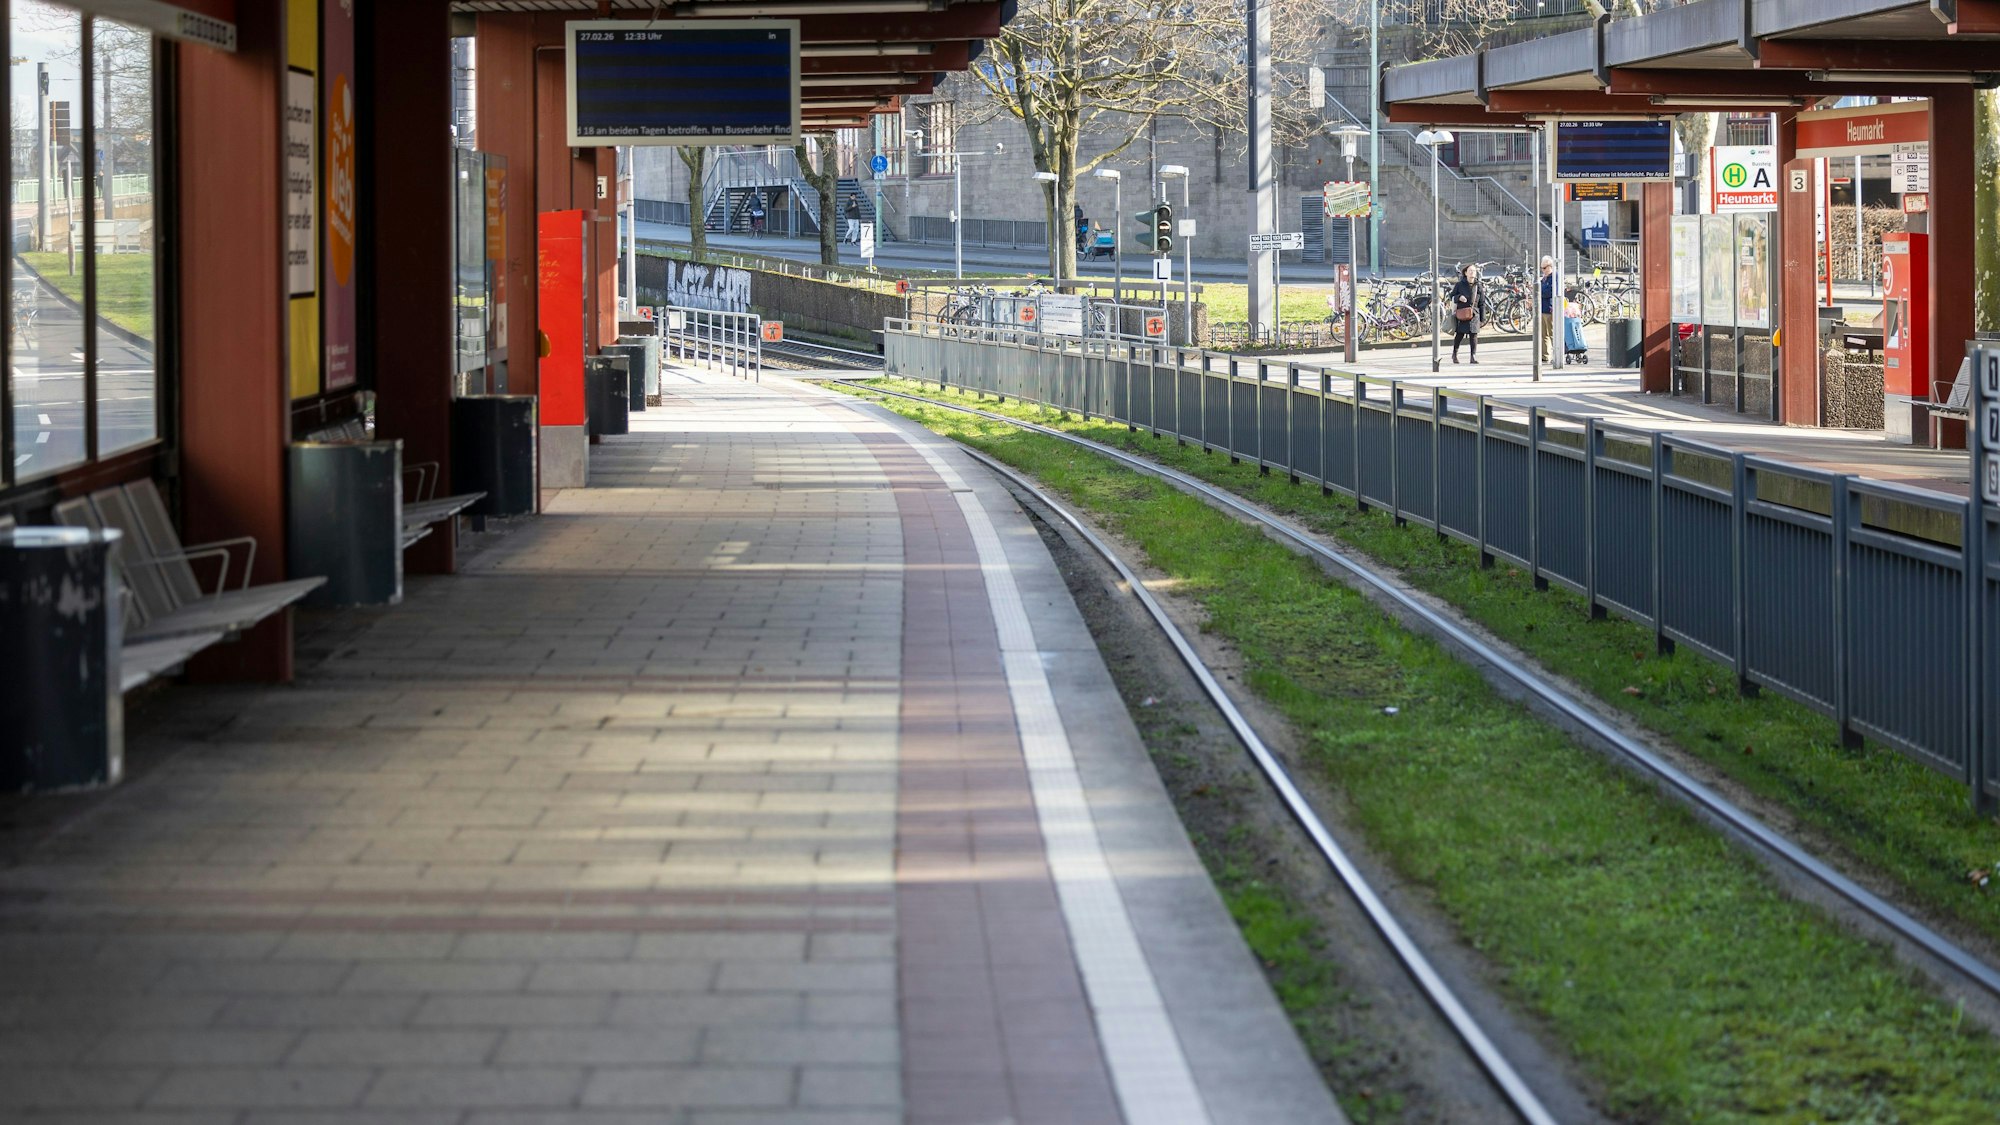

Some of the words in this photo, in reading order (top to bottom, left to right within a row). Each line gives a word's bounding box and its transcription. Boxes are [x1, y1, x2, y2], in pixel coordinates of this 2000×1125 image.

[580, 33, 615, 41] 27.02.26
[624, 33, 646, 41] 12:33
[648, 32, 663, 40] Uhr
[768, 32, 776, 40] in
[583, 127, 595, 135] 18
[608, 126, 639, 135] beiden
[640, 126, 666, 136] Tagen
[667, 125, 710, 135] betroffen.
[712, 126, 724, 134] Im
[725, 125, 772, 135] Busverkehr
[774, 125, 791, 134] find
[1846, 118, 1885, 142] Heumarkt
[331, 139, 354, 222] lieb
[1753, 168, 1771, 188] A
[1793, 177, 1804, 191] 3
[1719, 193, 1775, 204] Heumarkt
[863, 225, 870, 238] 7
[1156, 261, 1167, 280] L
[1990, 360, 1996, 387] 1
[1990, 413, 1998, 438] 7
[1990, 464, 1997, 490] 9
